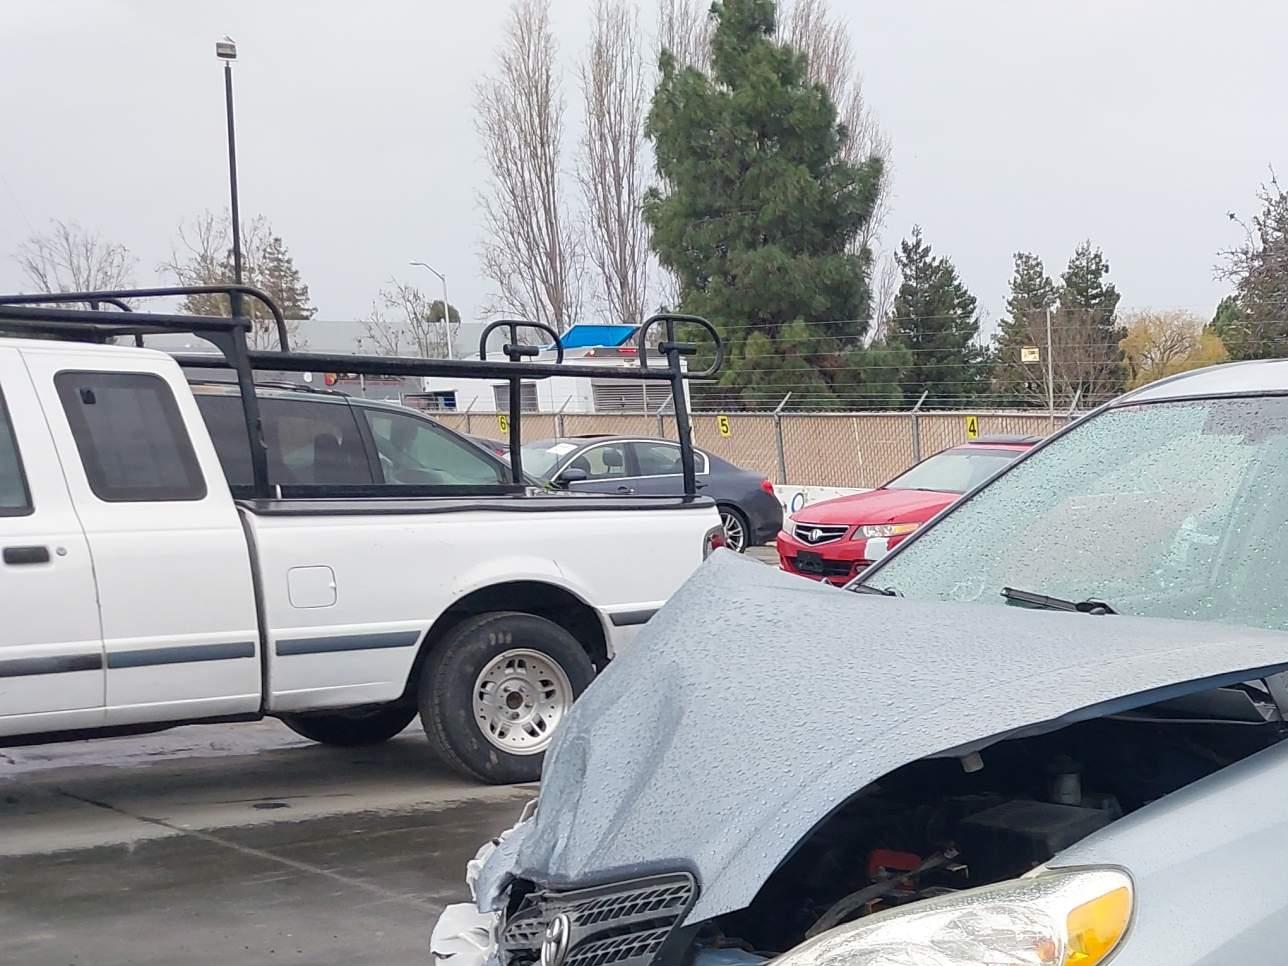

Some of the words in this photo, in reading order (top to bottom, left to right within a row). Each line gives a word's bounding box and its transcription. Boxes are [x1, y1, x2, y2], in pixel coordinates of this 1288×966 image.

[500, 416, 507, 430] 6
[720, 418, 729, 434] 5
[968, 418, 977, 436] 4
